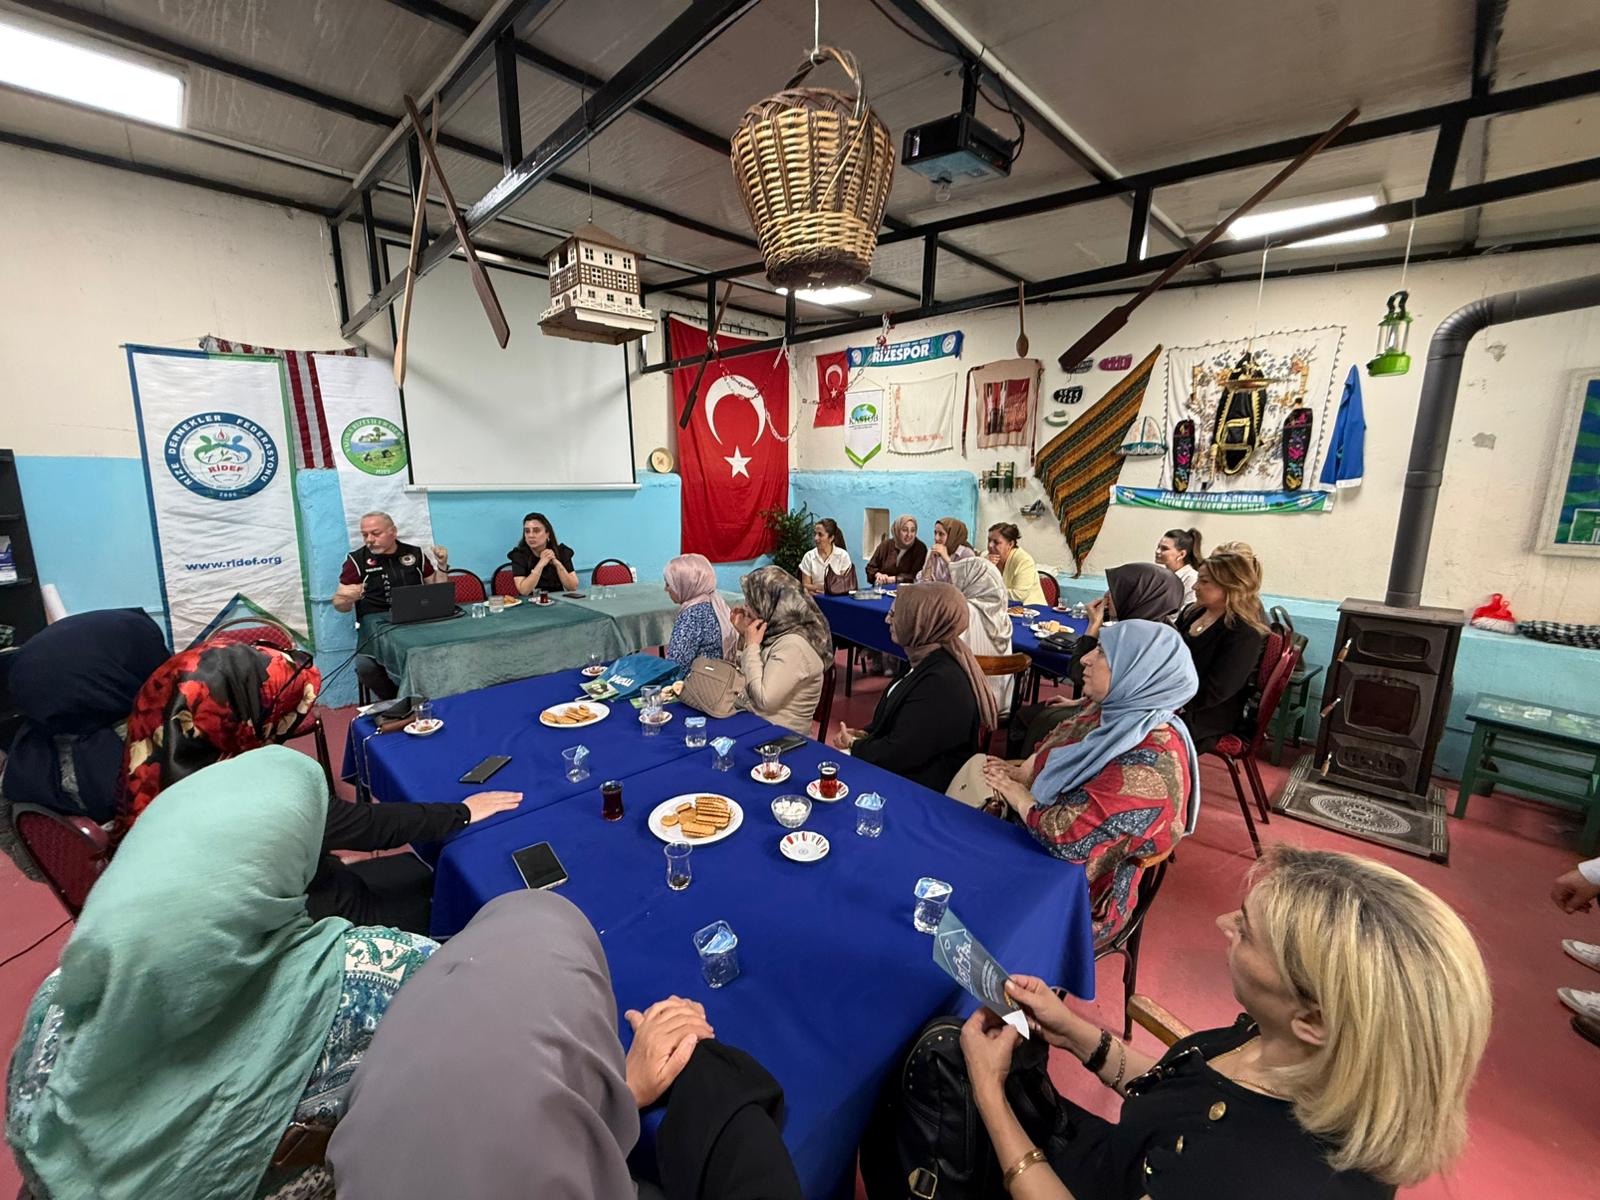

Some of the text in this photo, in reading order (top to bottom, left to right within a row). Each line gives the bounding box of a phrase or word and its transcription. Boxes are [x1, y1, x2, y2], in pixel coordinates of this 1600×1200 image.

[872, 343, 930, 363] RİZESPOR
[168, 414, 275, 486] RİZE DERNEKLER FEDERASYONU
[185, 556, 282, 571] www.ridef.org
